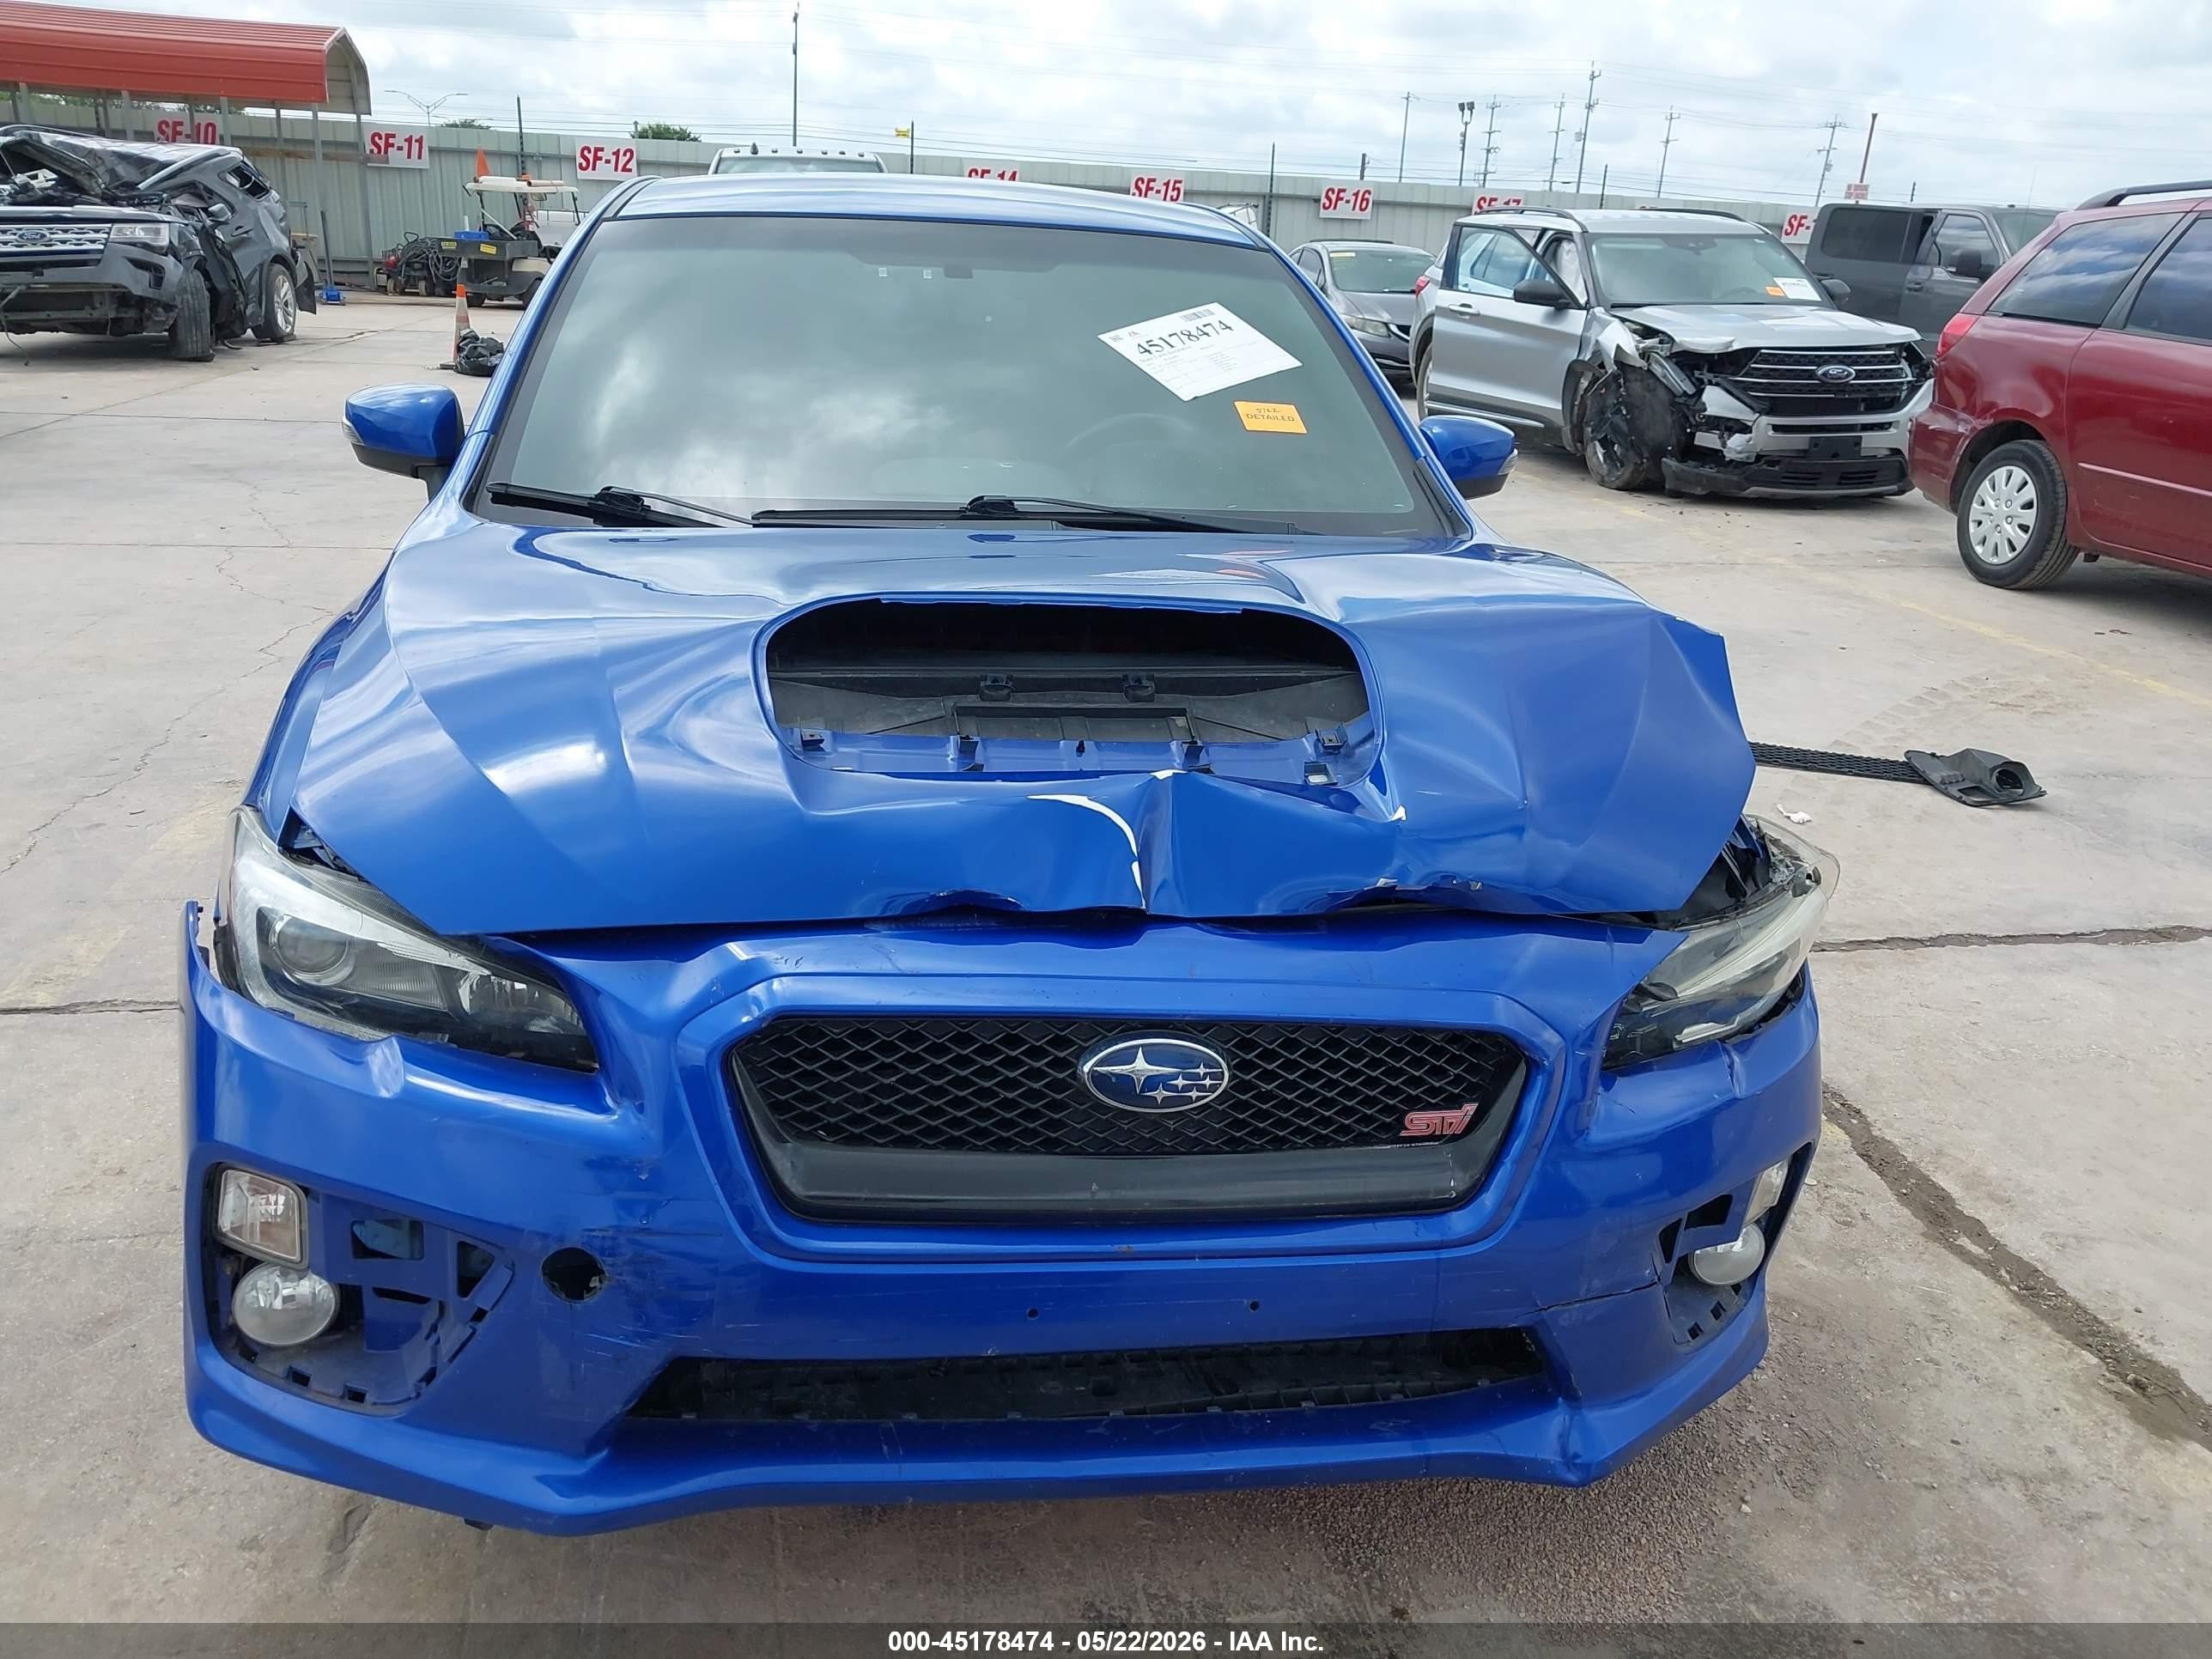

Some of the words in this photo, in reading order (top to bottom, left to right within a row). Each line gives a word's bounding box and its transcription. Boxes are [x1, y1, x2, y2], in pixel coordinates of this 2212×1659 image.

[156, 119, 216, 144] SF-10
[369, 131, 424, 160] SF-11
[578, 145, 635, 173] SF-12
[1132, 177, 1183, 202] SF-15
[1322, 186, 1371, 212] SF-16
[1137, 319, 1234, 355] 45178474
[1246, 413, 1296, 422] DETAILED
